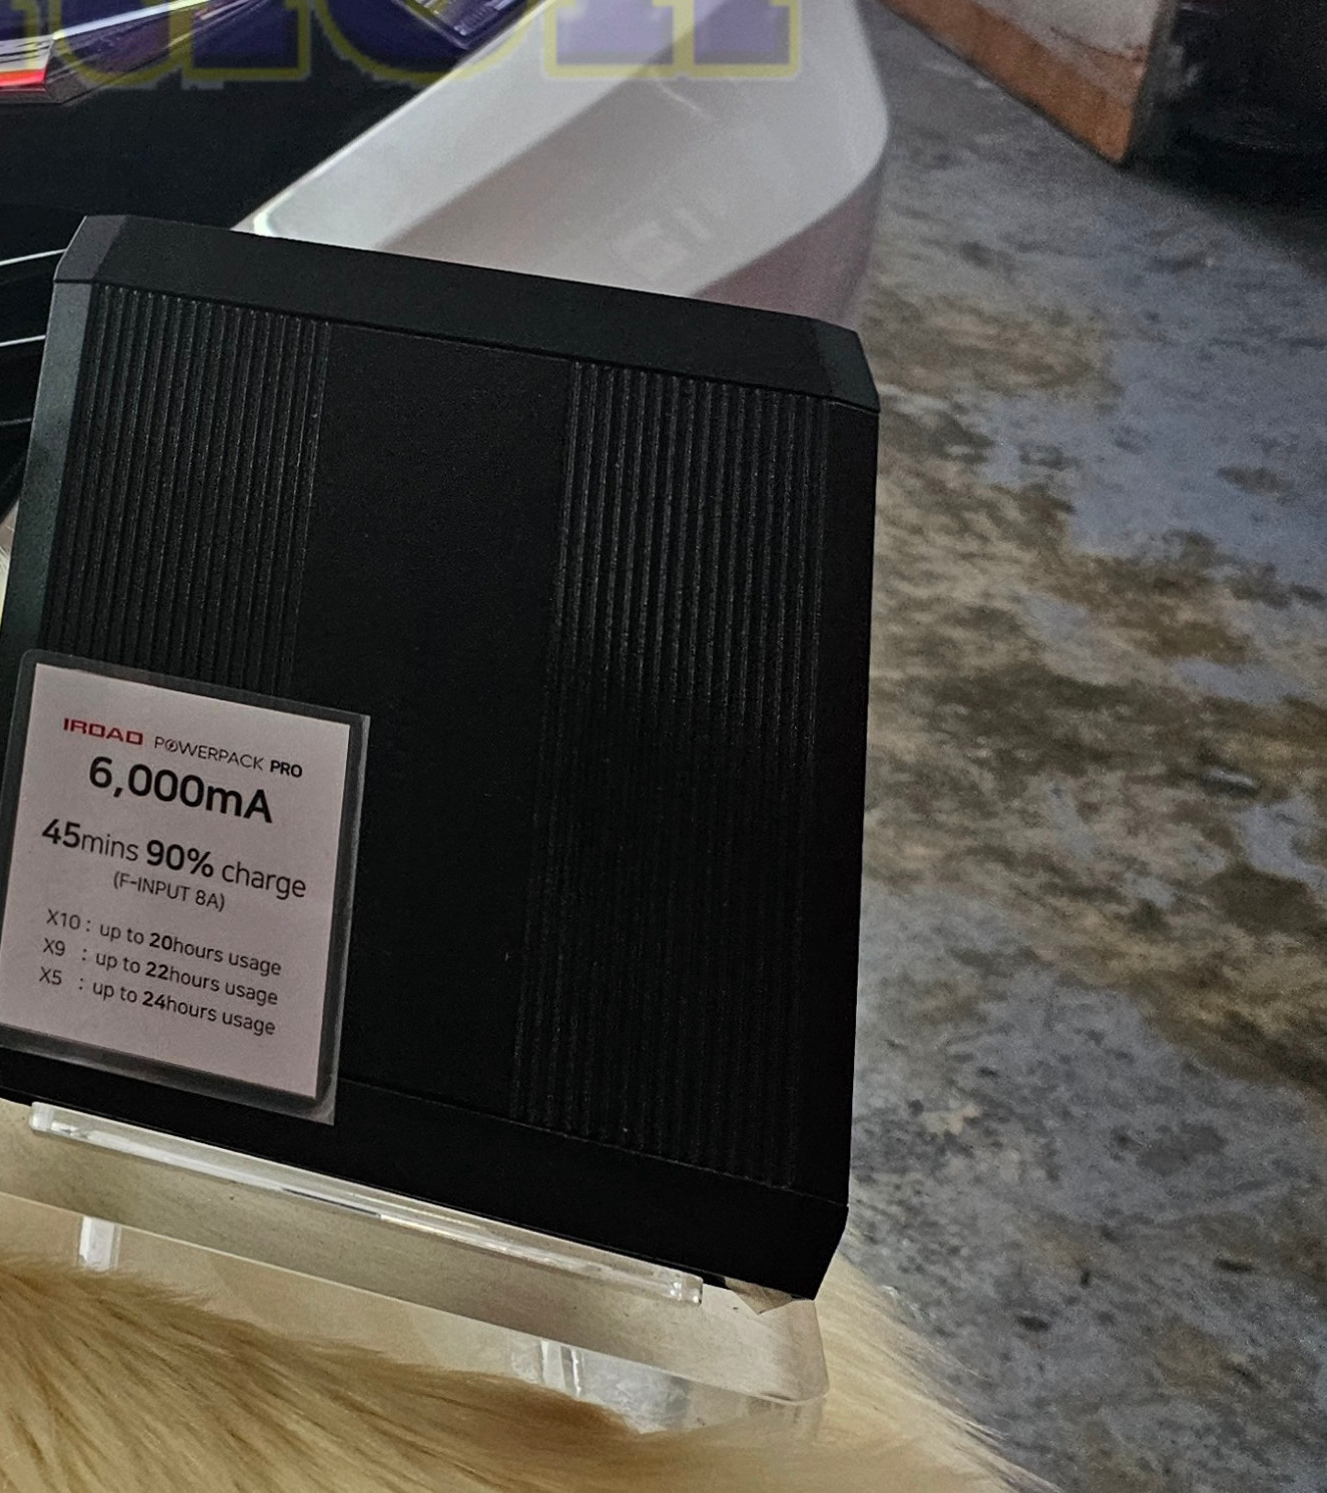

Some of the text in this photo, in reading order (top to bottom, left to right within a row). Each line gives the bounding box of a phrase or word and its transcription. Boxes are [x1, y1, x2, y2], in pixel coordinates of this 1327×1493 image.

[62, 717, 144, 746] IROAD
[270, 760, 303, 779] PRO
[89, 755, 273, 825] 6,000mA
[41, 818, 307, 900] 45mins 90% charge
[113, 871, 226, 912] (F-INPUT 8A)
[43, 938, 66, 957] X9
[95, 953, 118, 972] up
[121, 956, 141, 975] to
[146, 961, 220, 994] 22hours
[225, 981, 279, 1007] usage
[46, 909, 81, 931] X10
[99, 924, 121, 942] up
[125, 927, 145, 946] to
[149, 931, 224, 964] 20hours
[228, 950, 282, 978] usage
[39, 967, 62, 986] X5
[92, 982, 115, 1000] up
[119, 985, 138, 1004] to
[142, 991, 217, 1024] 24hours
[222, 1011, 276, 1037] usage
